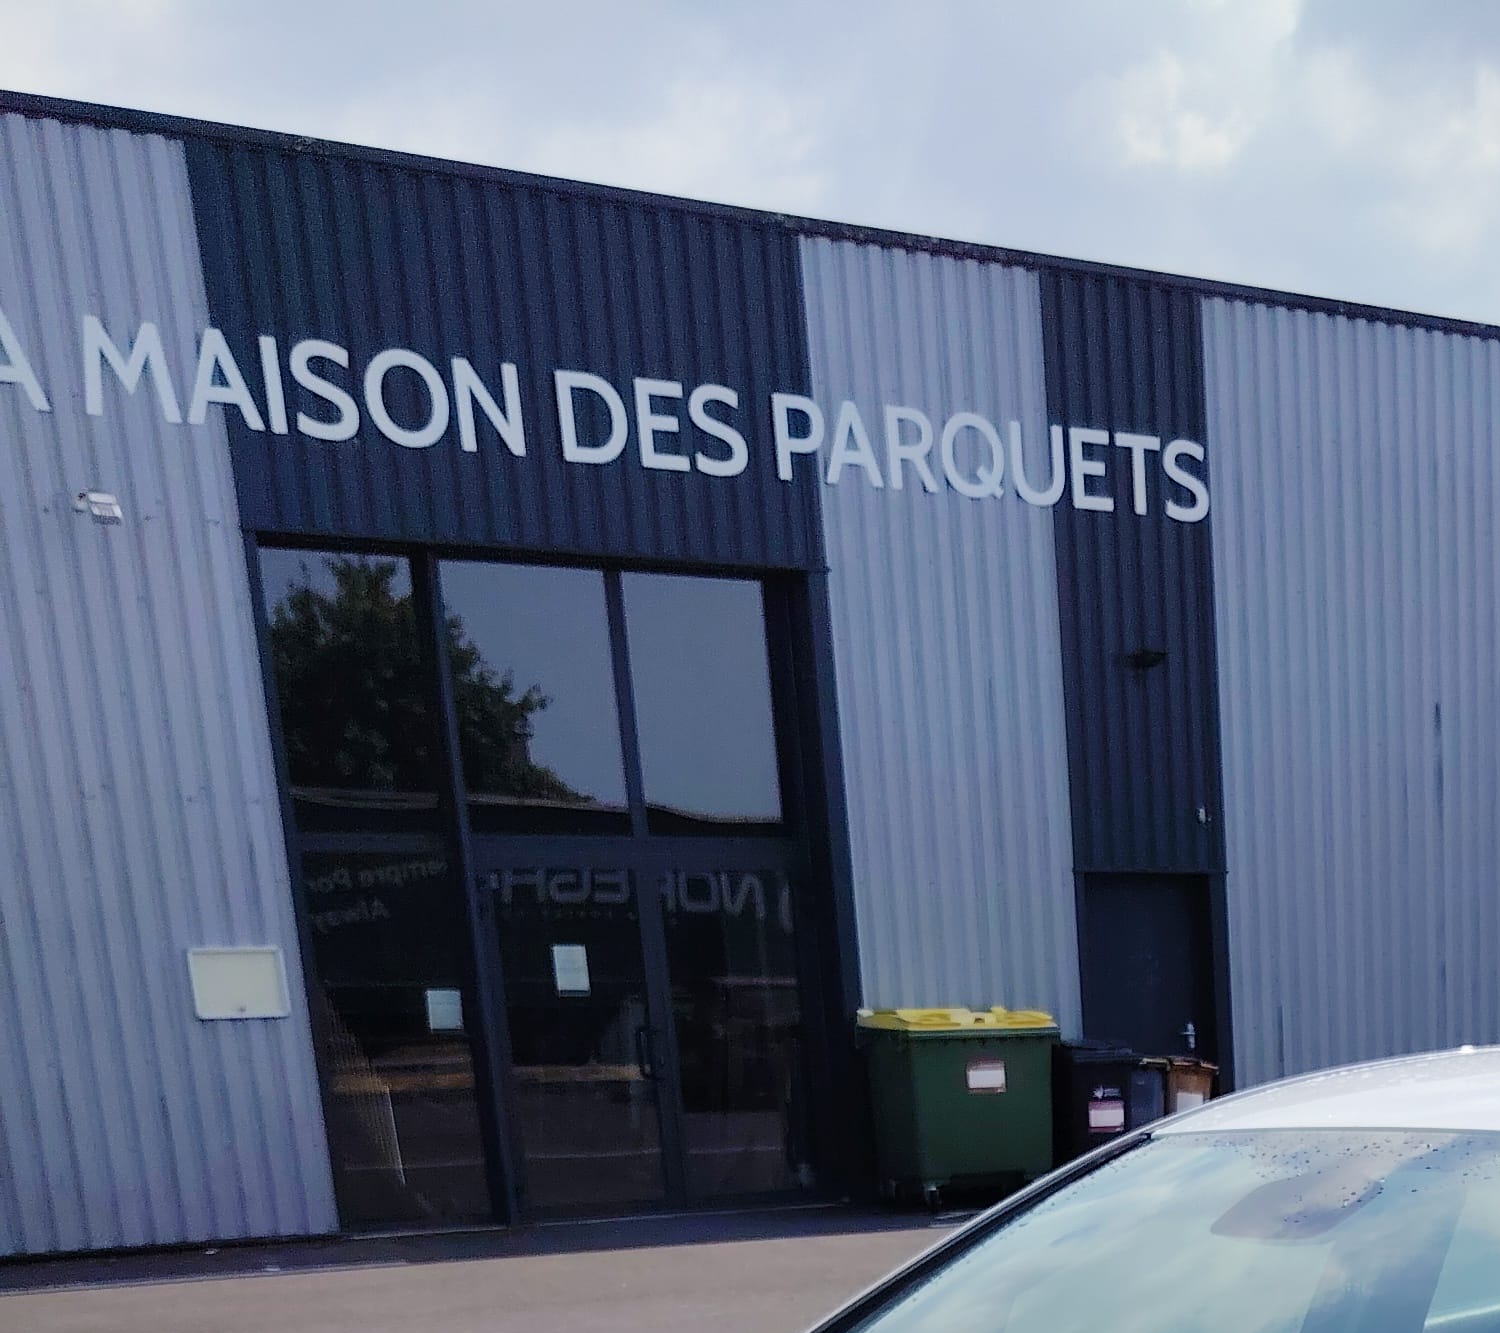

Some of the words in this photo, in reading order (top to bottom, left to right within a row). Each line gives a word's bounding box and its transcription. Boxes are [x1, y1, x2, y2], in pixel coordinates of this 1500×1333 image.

[0, 305, 52, 413] A
[83, 315, 527, 457] MAISON
[554, 369, 749, 477] DES
[770, 392, 1210, 523] PARQUETS
